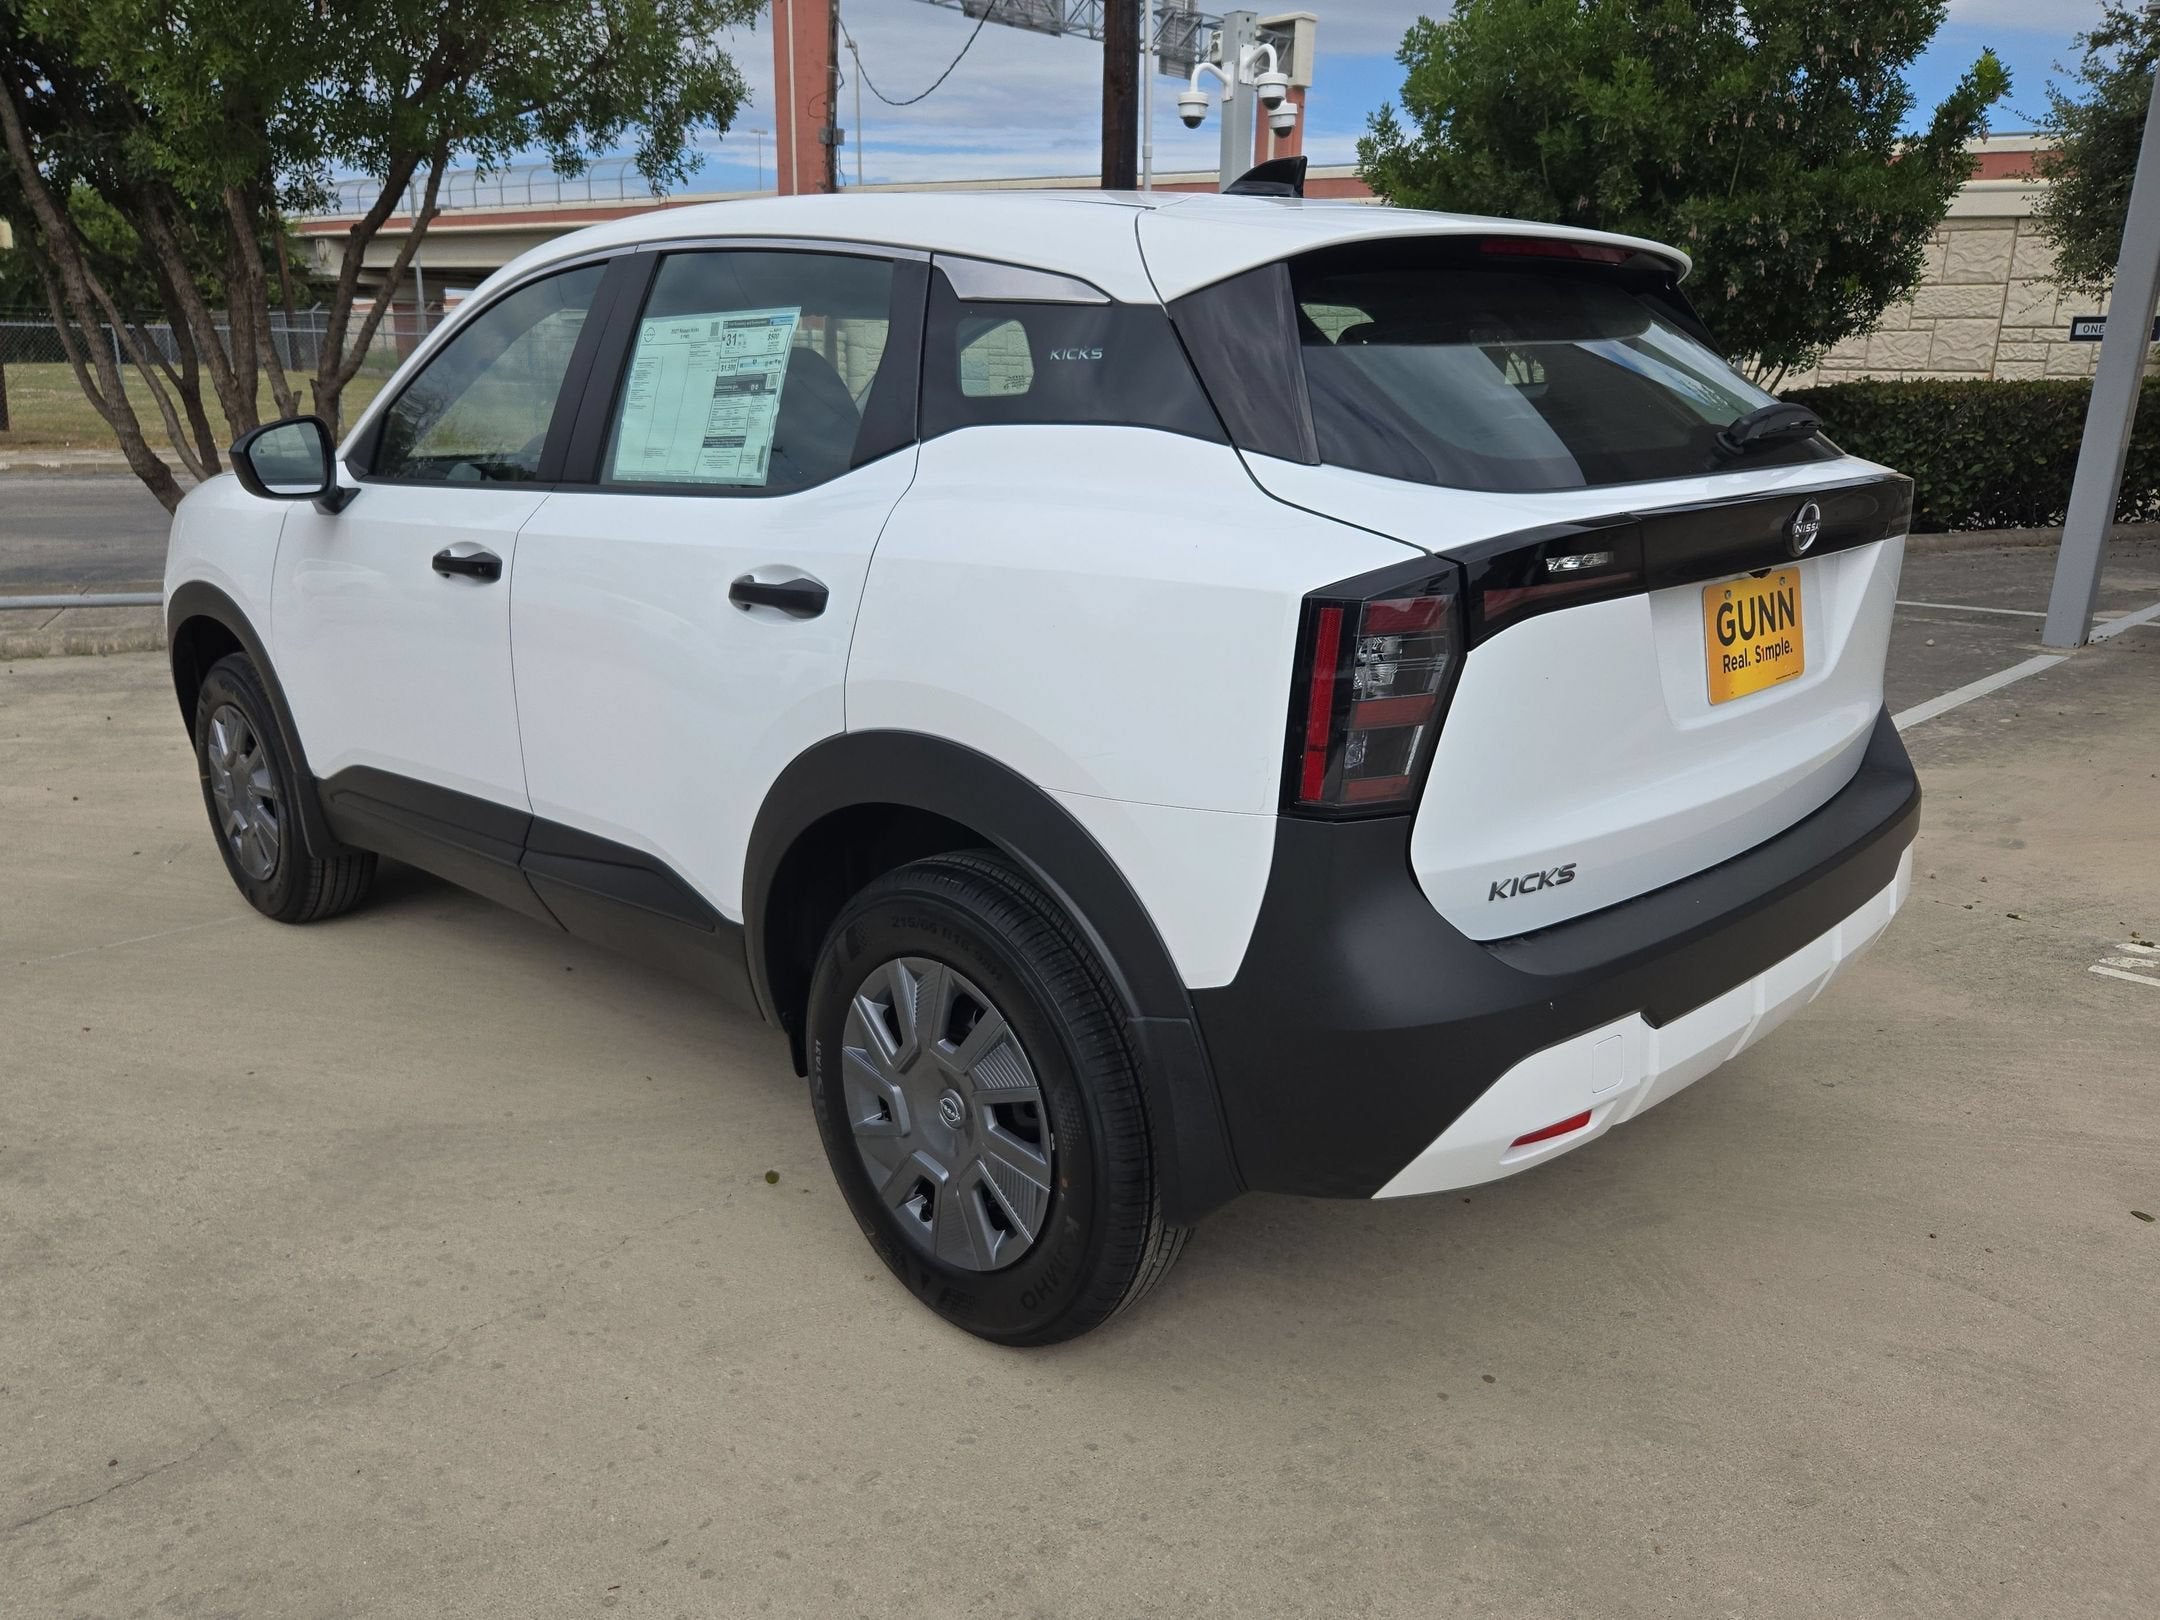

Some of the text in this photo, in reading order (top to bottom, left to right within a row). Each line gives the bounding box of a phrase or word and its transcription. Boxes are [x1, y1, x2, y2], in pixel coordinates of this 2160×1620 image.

[2082, 324, 2105, 334] ONE
[726, 333, 737, 346] 31
[1050, 348, 1103, 360] KICKS
[1795, 522, 1819, 533] NISSA
[1716, 587, 1795, 647] GUNN
[1722, 651, 1751, 674] Real.
[1488, 862, 1577, 901] KICKS
